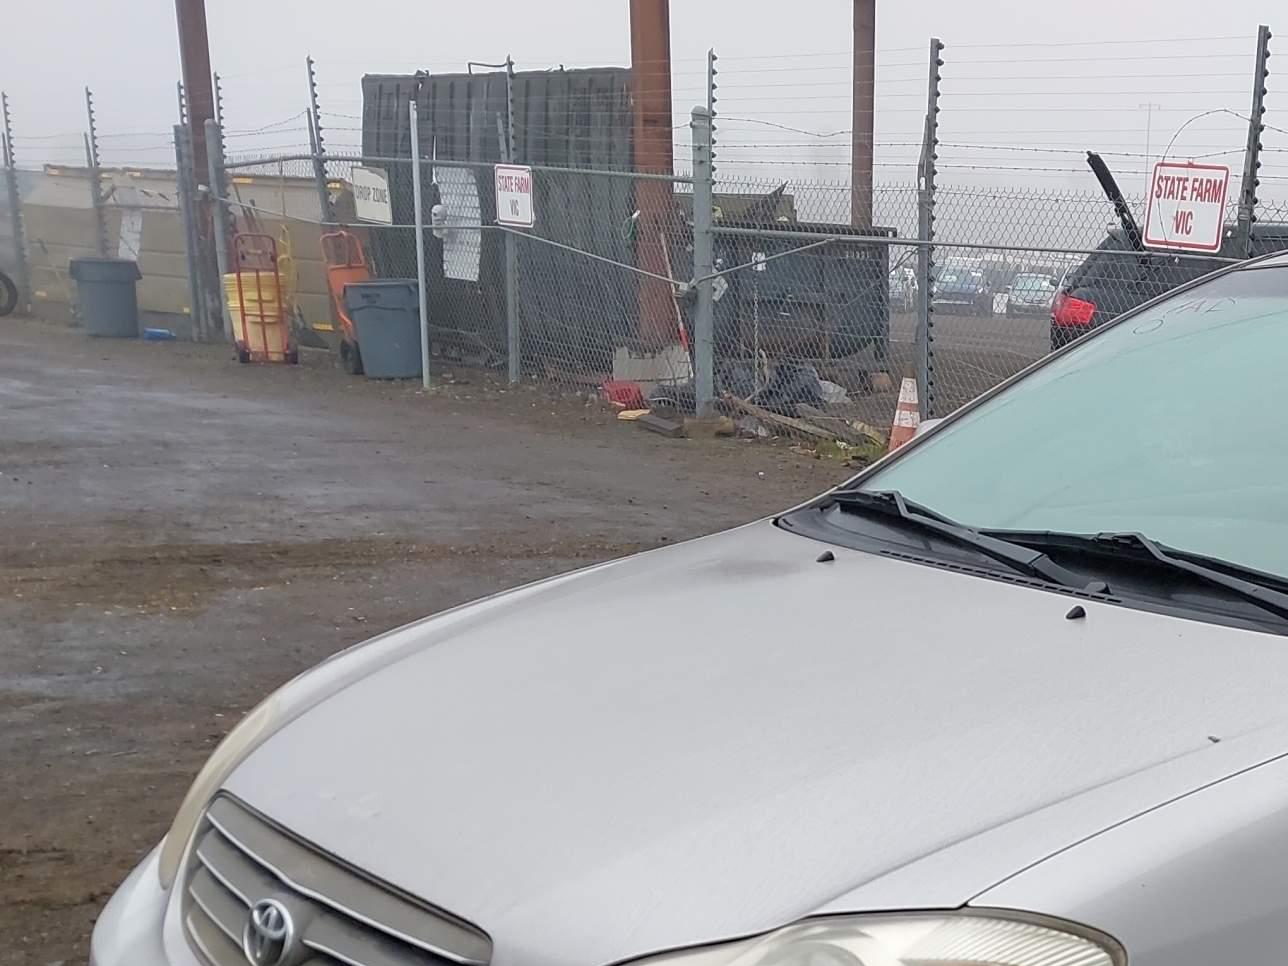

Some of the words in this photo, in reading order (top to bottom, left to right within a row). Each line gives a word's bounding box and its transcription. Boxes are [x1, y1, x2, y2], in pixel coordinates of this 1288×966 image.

[498, 175, 514, 193] STATE
[514, 175, 530, 193] FARM
[1155, 175, 1189, 201] STATE
[1190, 177, 1224, 204] FARM
[372, 187, 389, 204] ZONE
[509, 199, 520, 216] VIC
[1174, 210, 1193, 235] VIC
